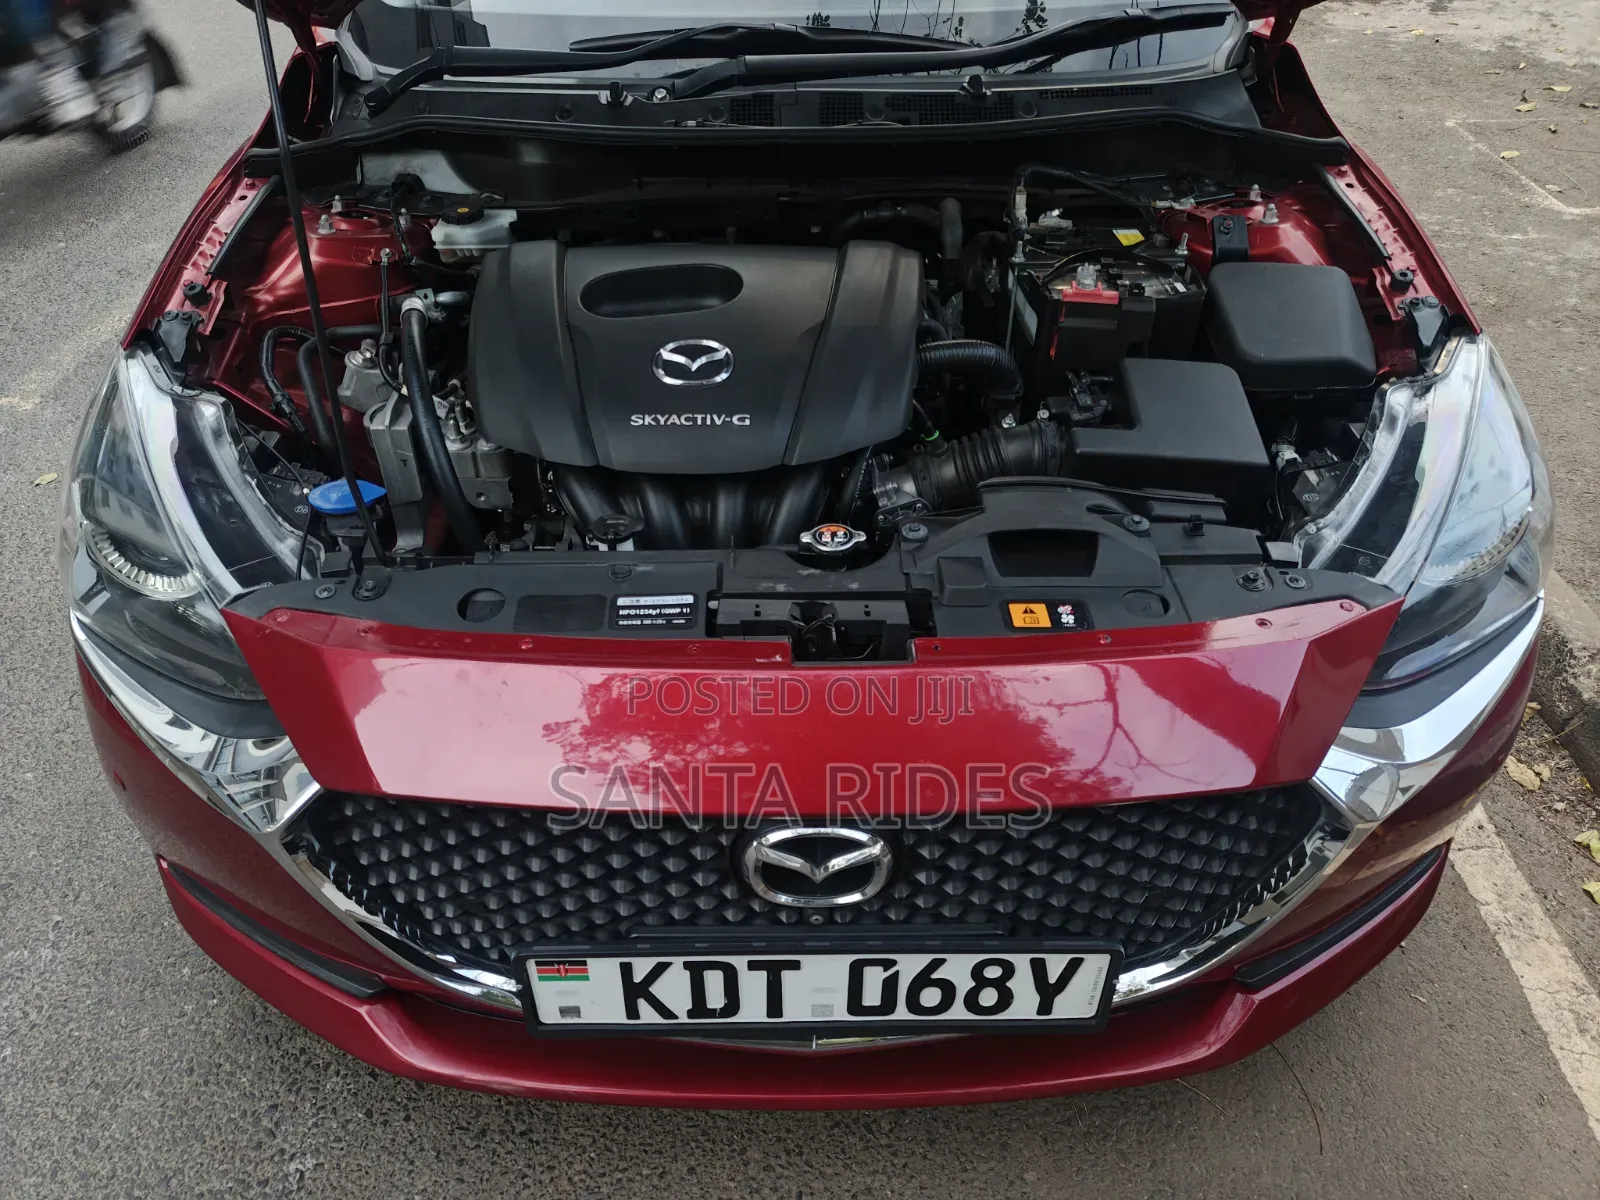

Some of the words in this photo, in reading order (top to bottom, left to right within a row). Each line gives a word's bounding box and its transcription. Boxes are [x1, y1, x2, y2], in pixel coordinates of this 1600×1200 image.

[630, 413, 751, 426] SKYACTIV-G
[618, 959, 802, 1021] KDT
[846, 957, 1085, 1017] 068Y
